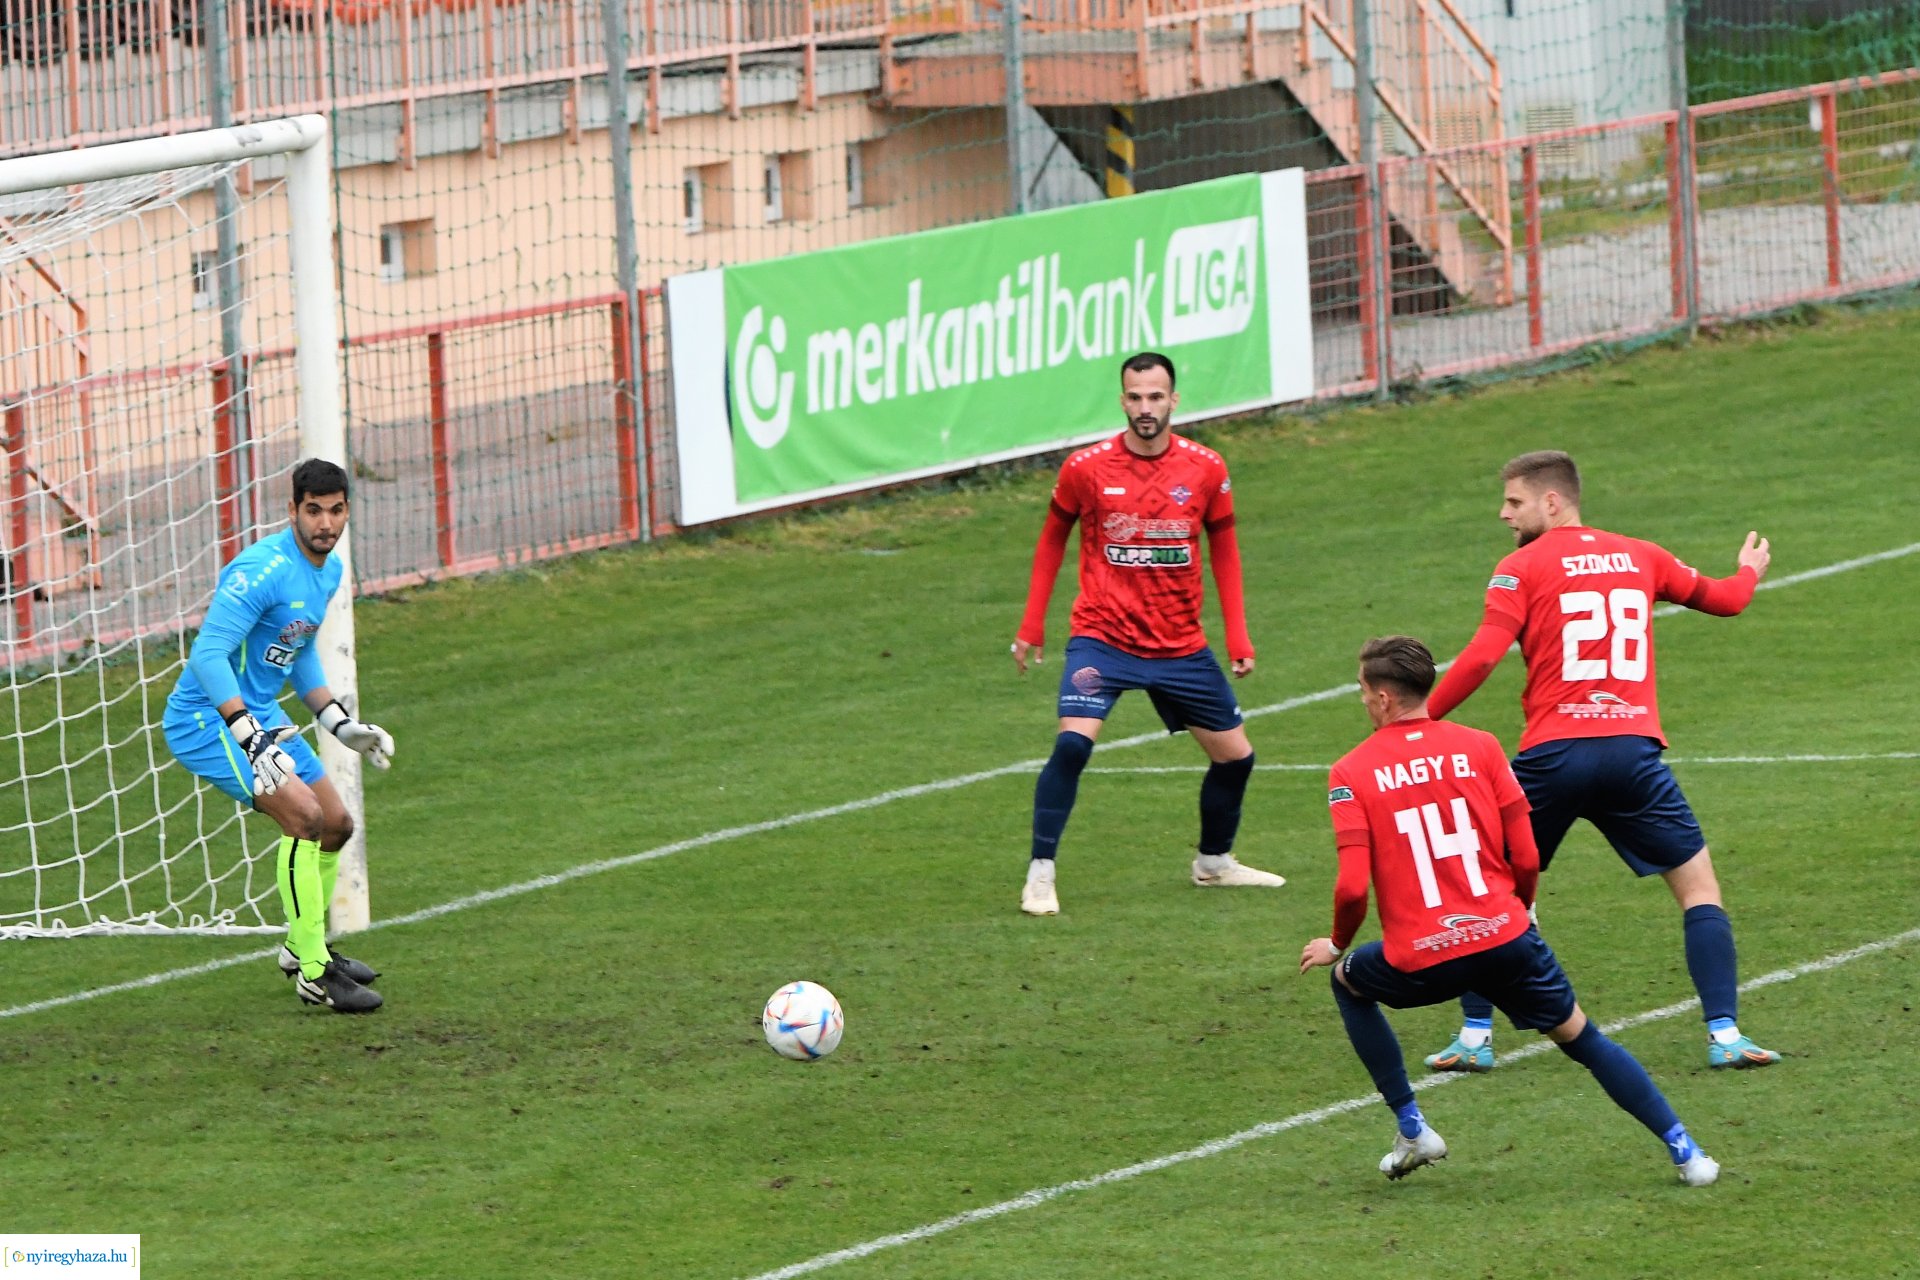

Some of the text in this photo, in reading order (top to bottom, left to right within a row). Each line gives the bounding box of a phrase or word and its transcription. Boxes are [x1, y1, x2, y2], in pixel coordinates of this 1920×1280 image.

[806, 238, 1249, 415] merkantilbank LIGA
[1561, 553, 1640, 577] SZOKOL
[1559, 588, 1648, 682] 28
[1374, 753, 1477, 792] NAGY B.
[1394, 797, 1489, 909] 14
